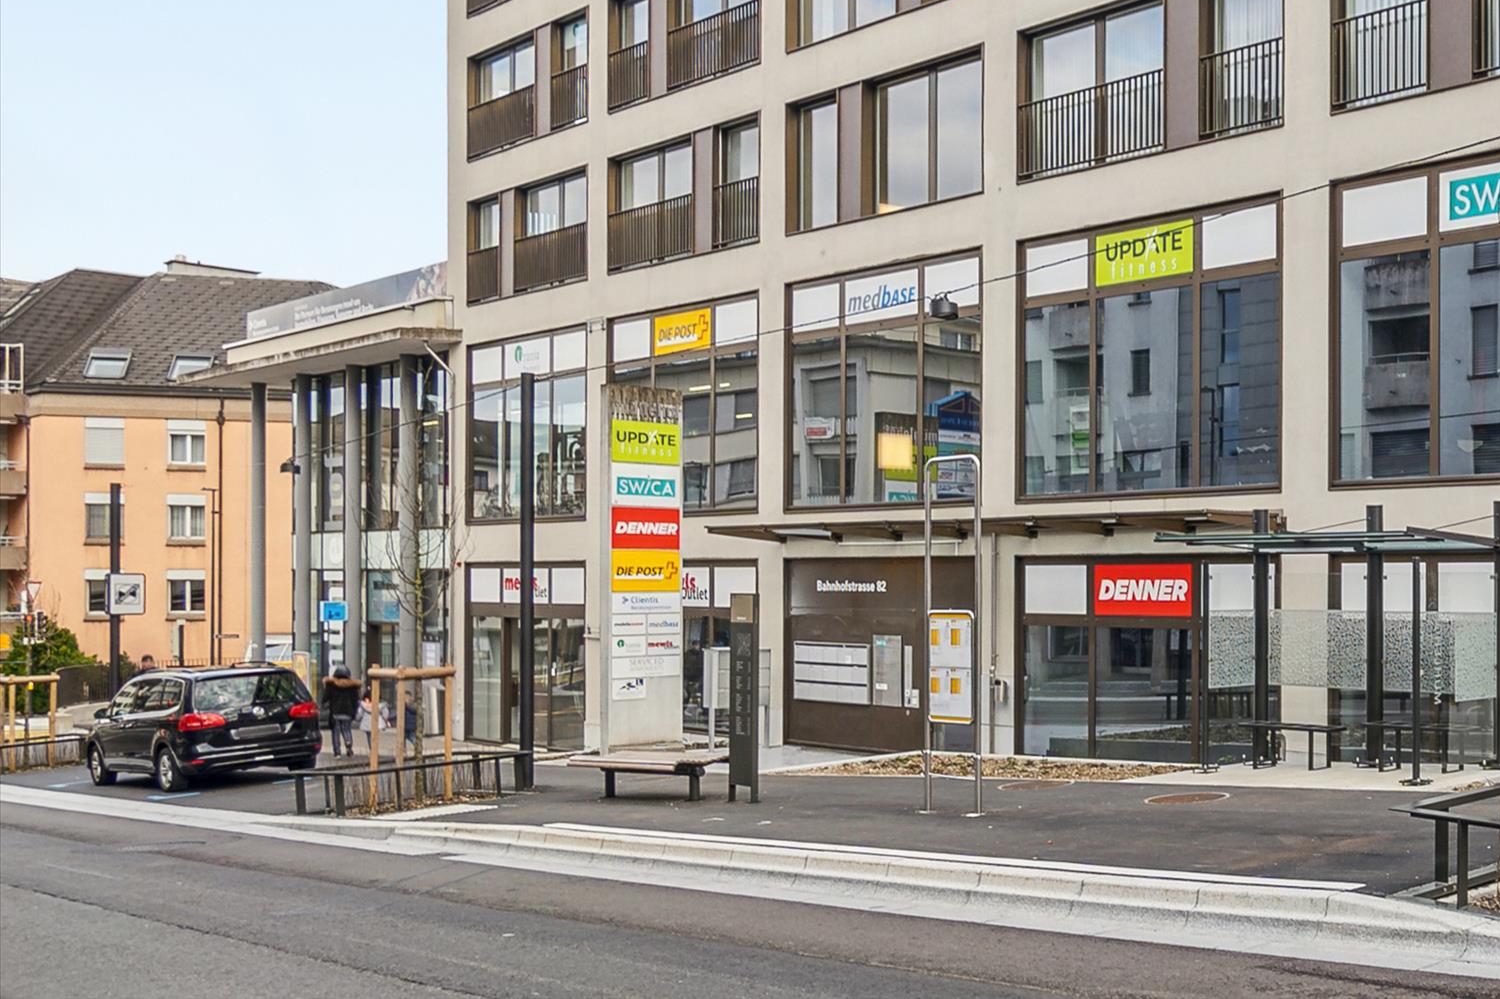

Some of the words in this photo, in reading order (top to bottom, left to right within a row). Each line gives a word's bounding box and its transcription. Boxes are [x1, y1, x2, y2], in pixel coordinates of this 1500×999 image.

[1106, 228, 1182, 261] UPDATE
[1111, 257, 1177, 281] fitness
[658, 327, 673, 342] DIE
[674, 323, 697, 339] POST
[616, 430, 676, 446] UPDATE
[615, 521, 678, 536] DENNER
[616, 567, 634, 576] DIE
[636, 567, 664, 577] POST
[816, 580, 875, 592] Bahnhofstrasse
[876, 580, 887, 592] 82
[1098, 579, 1188, 602] DENNER
